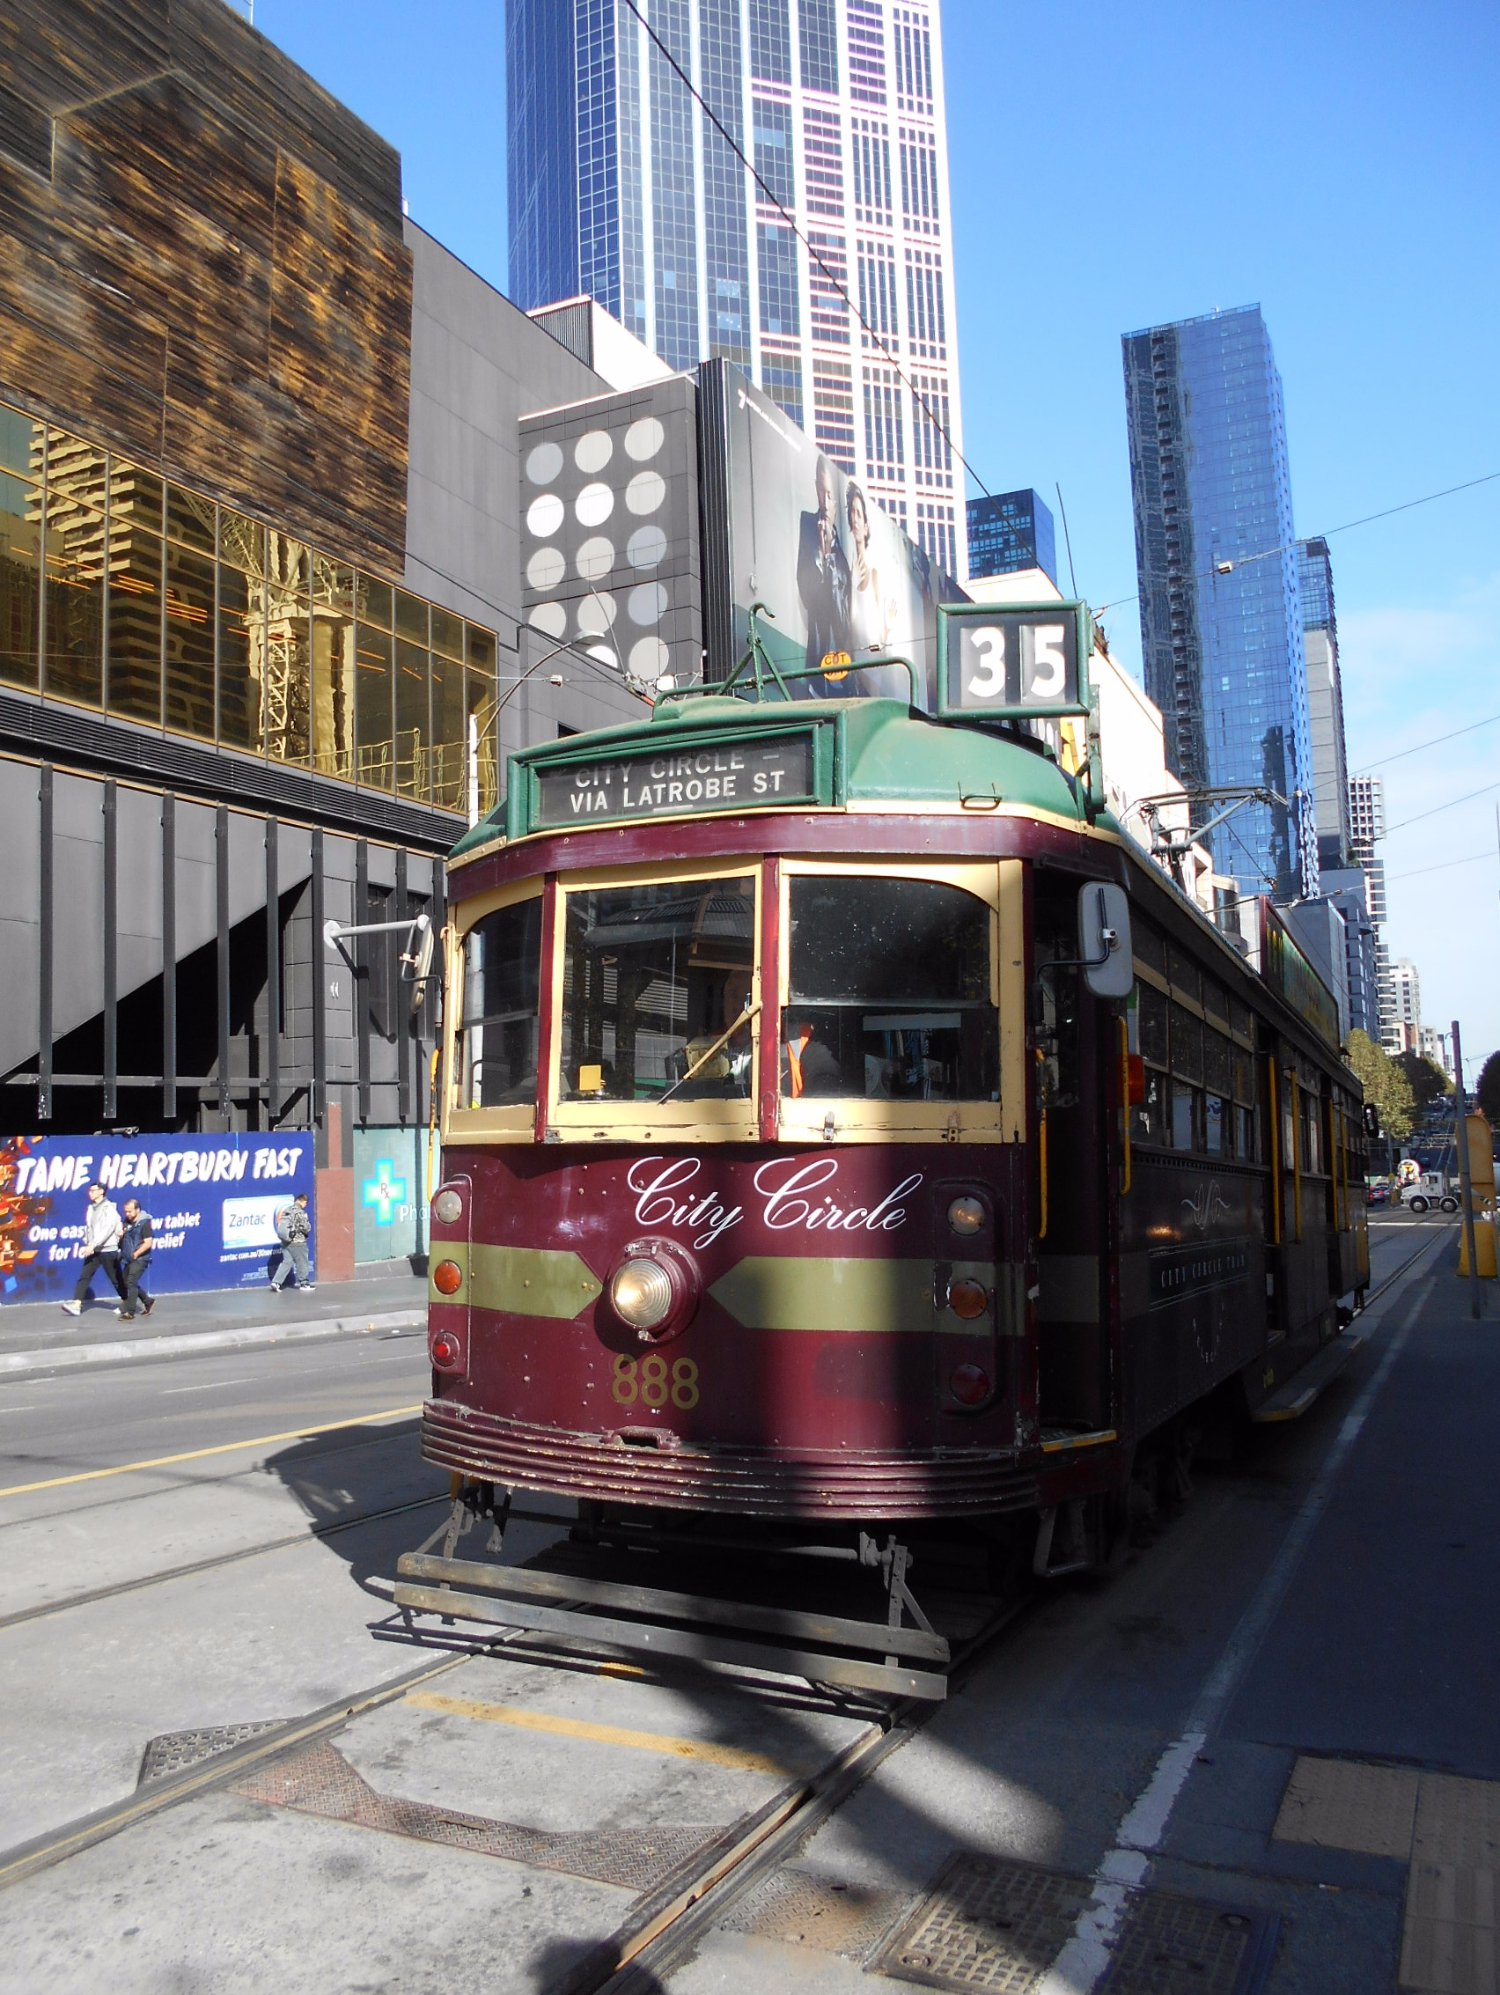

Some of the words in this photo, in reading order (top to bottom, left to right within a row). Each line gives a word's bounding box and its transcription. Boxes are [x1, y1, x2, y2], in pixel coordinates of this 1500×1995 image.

[824, 653, 846, 665] CUT
[967, 626, 1066, 697] 35
[575, 762, 633, 788] CITY
[650, 749, 745, 779] CIRCLE
[570, 790, 608, 813] VIA
[623, 776, 737, 808] LATROBE
[753, 770, 785, 793] ST
[15, 1155, 93, 1195] TAME
[99, 1148, 249, 1189] HEARTBURN
[252, 1147, 303, 1180] FAST
[229, 1213, 266, 1228] Zantac
[627, 1156, 744, 1249] City
[753, 1157, 923, 1232] Circle
[29, 1225, 58, 1242] One
[165, 1211, 201, 1230] tablet
[49, 1244, 71, 1261] for
[151, 1231, 186, 1250] relief
[612, 1353, 700, 1410] 888
